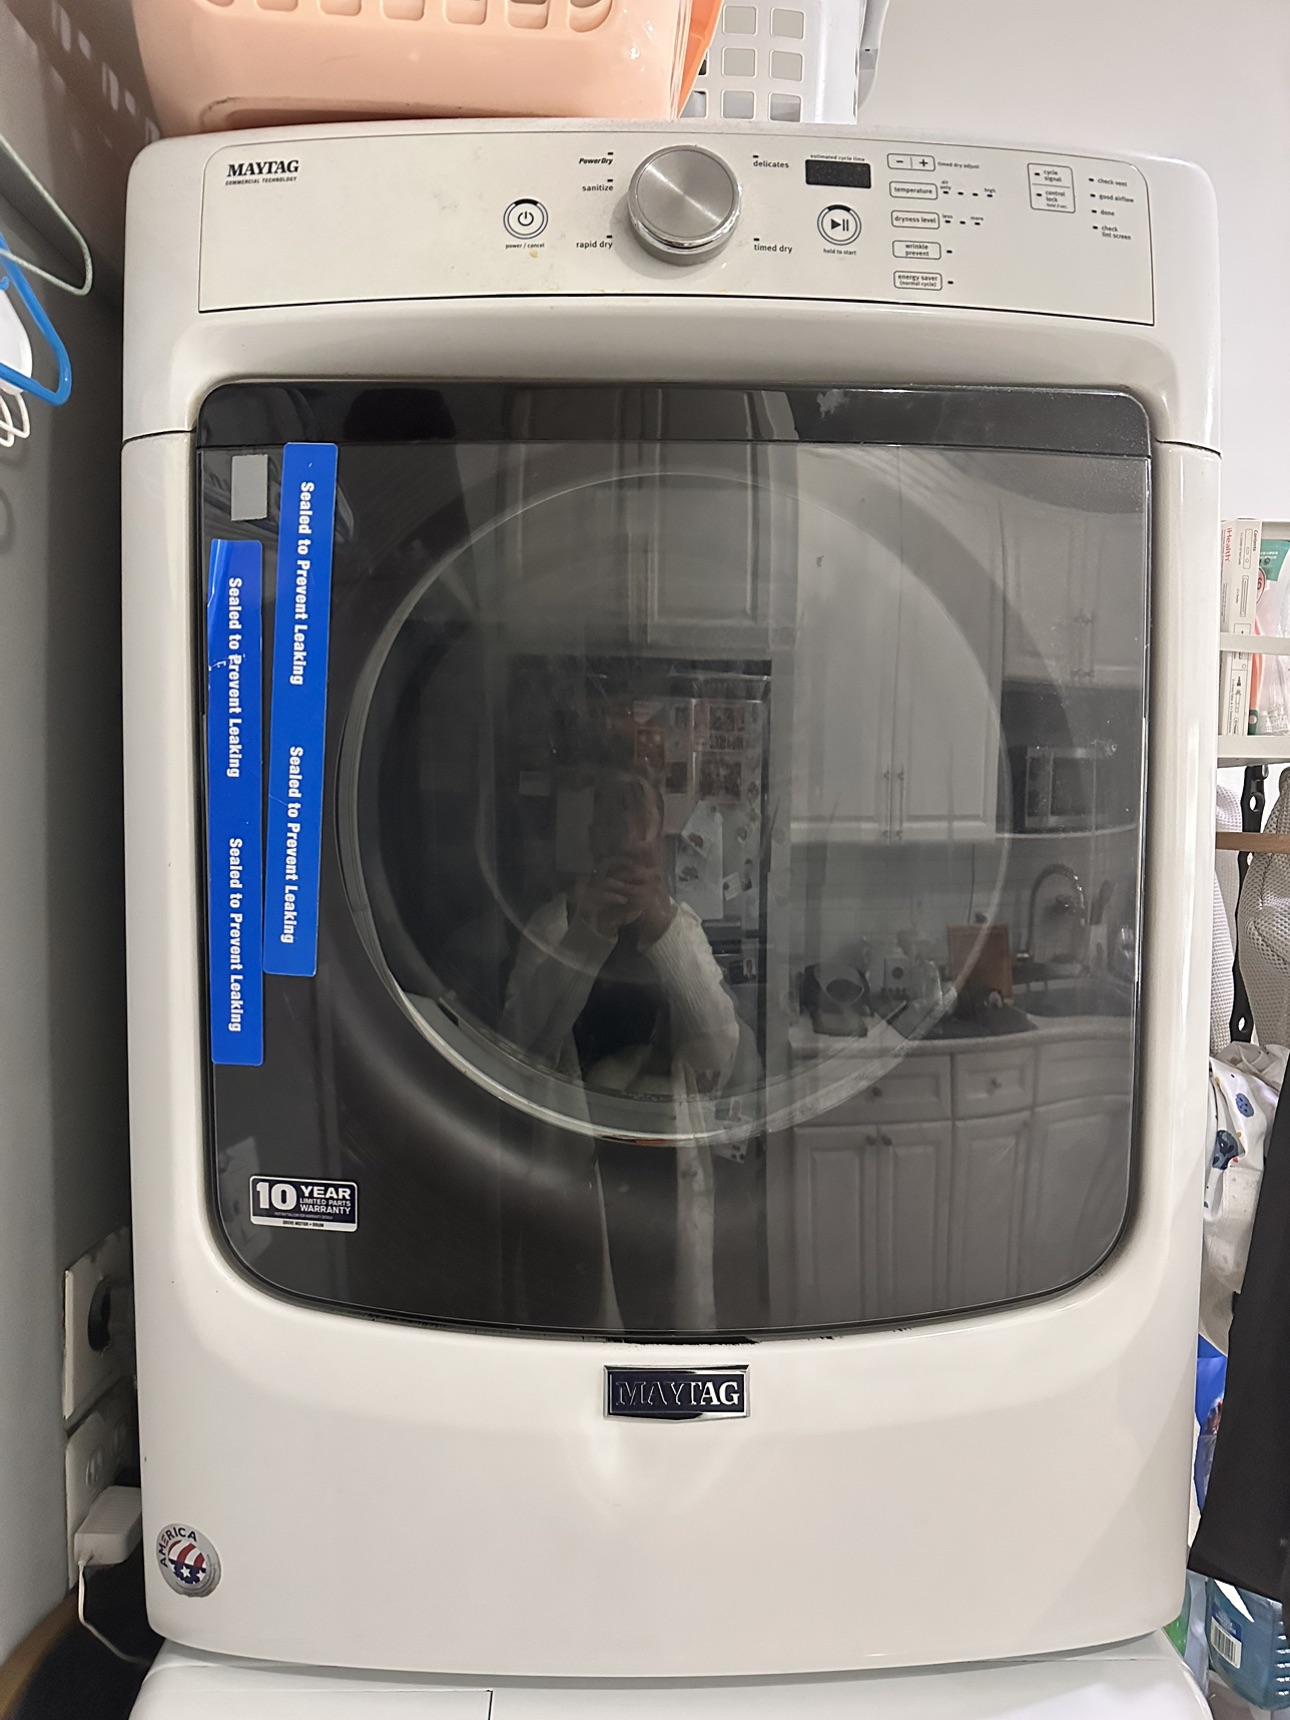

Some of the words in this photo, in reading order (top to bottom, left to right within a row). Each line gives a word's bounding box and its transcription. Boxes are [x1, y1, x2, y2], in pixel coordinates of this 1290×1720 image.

[226, 159, 299, 177] MAYTAG
[753, 160, 789, 168] delicates
[225, 178, 260, 186] COMMERCIAL
[894, 186, 933, 194] temperature
[894, 215, 920, 223] dryness
[576, 241, 597, 249] rapid
[599, 241, 613, 249] dry
[754, 244, 777, 252] timed
[779, 245, 792, 254] dry
[298, 481, 314, 534] Sealed
[296, 538, 309, 554] to
[1225, 527, 1233, 561] iHealth
[294, 559, 310, 619] Prevent
[228, 577, 243, 630] Sealed
[228, 633, 242, 650] to
[289, 624, 308, 685] Leaking
[228, 654, 243, 714] Prevent
[226, 718, 243, 778] Leaking
[288, 746, 303, 798] Sealed
[286, 801, 300, 818] to
[228, 838, 243, 889] Sealed
[284, 822, 300, 881] Prevent
[229, 892, 242, 908] to
[280, 885, 298, 944] Leaking
[229, 913, 243, 970] Prevent
[227, 974, 244, 1032] Leaking
[256, 1182, 297, 1210] 10
[300, 1185, 351, 1200] YEAR
[300, 1198, 327, 1206] LIMITED
[300, 1204, 351, 1215] WARRANTY
[615, 1381, 740, 1405] MAYTAG
[158, 1526, 197, 1568] AMERICA
